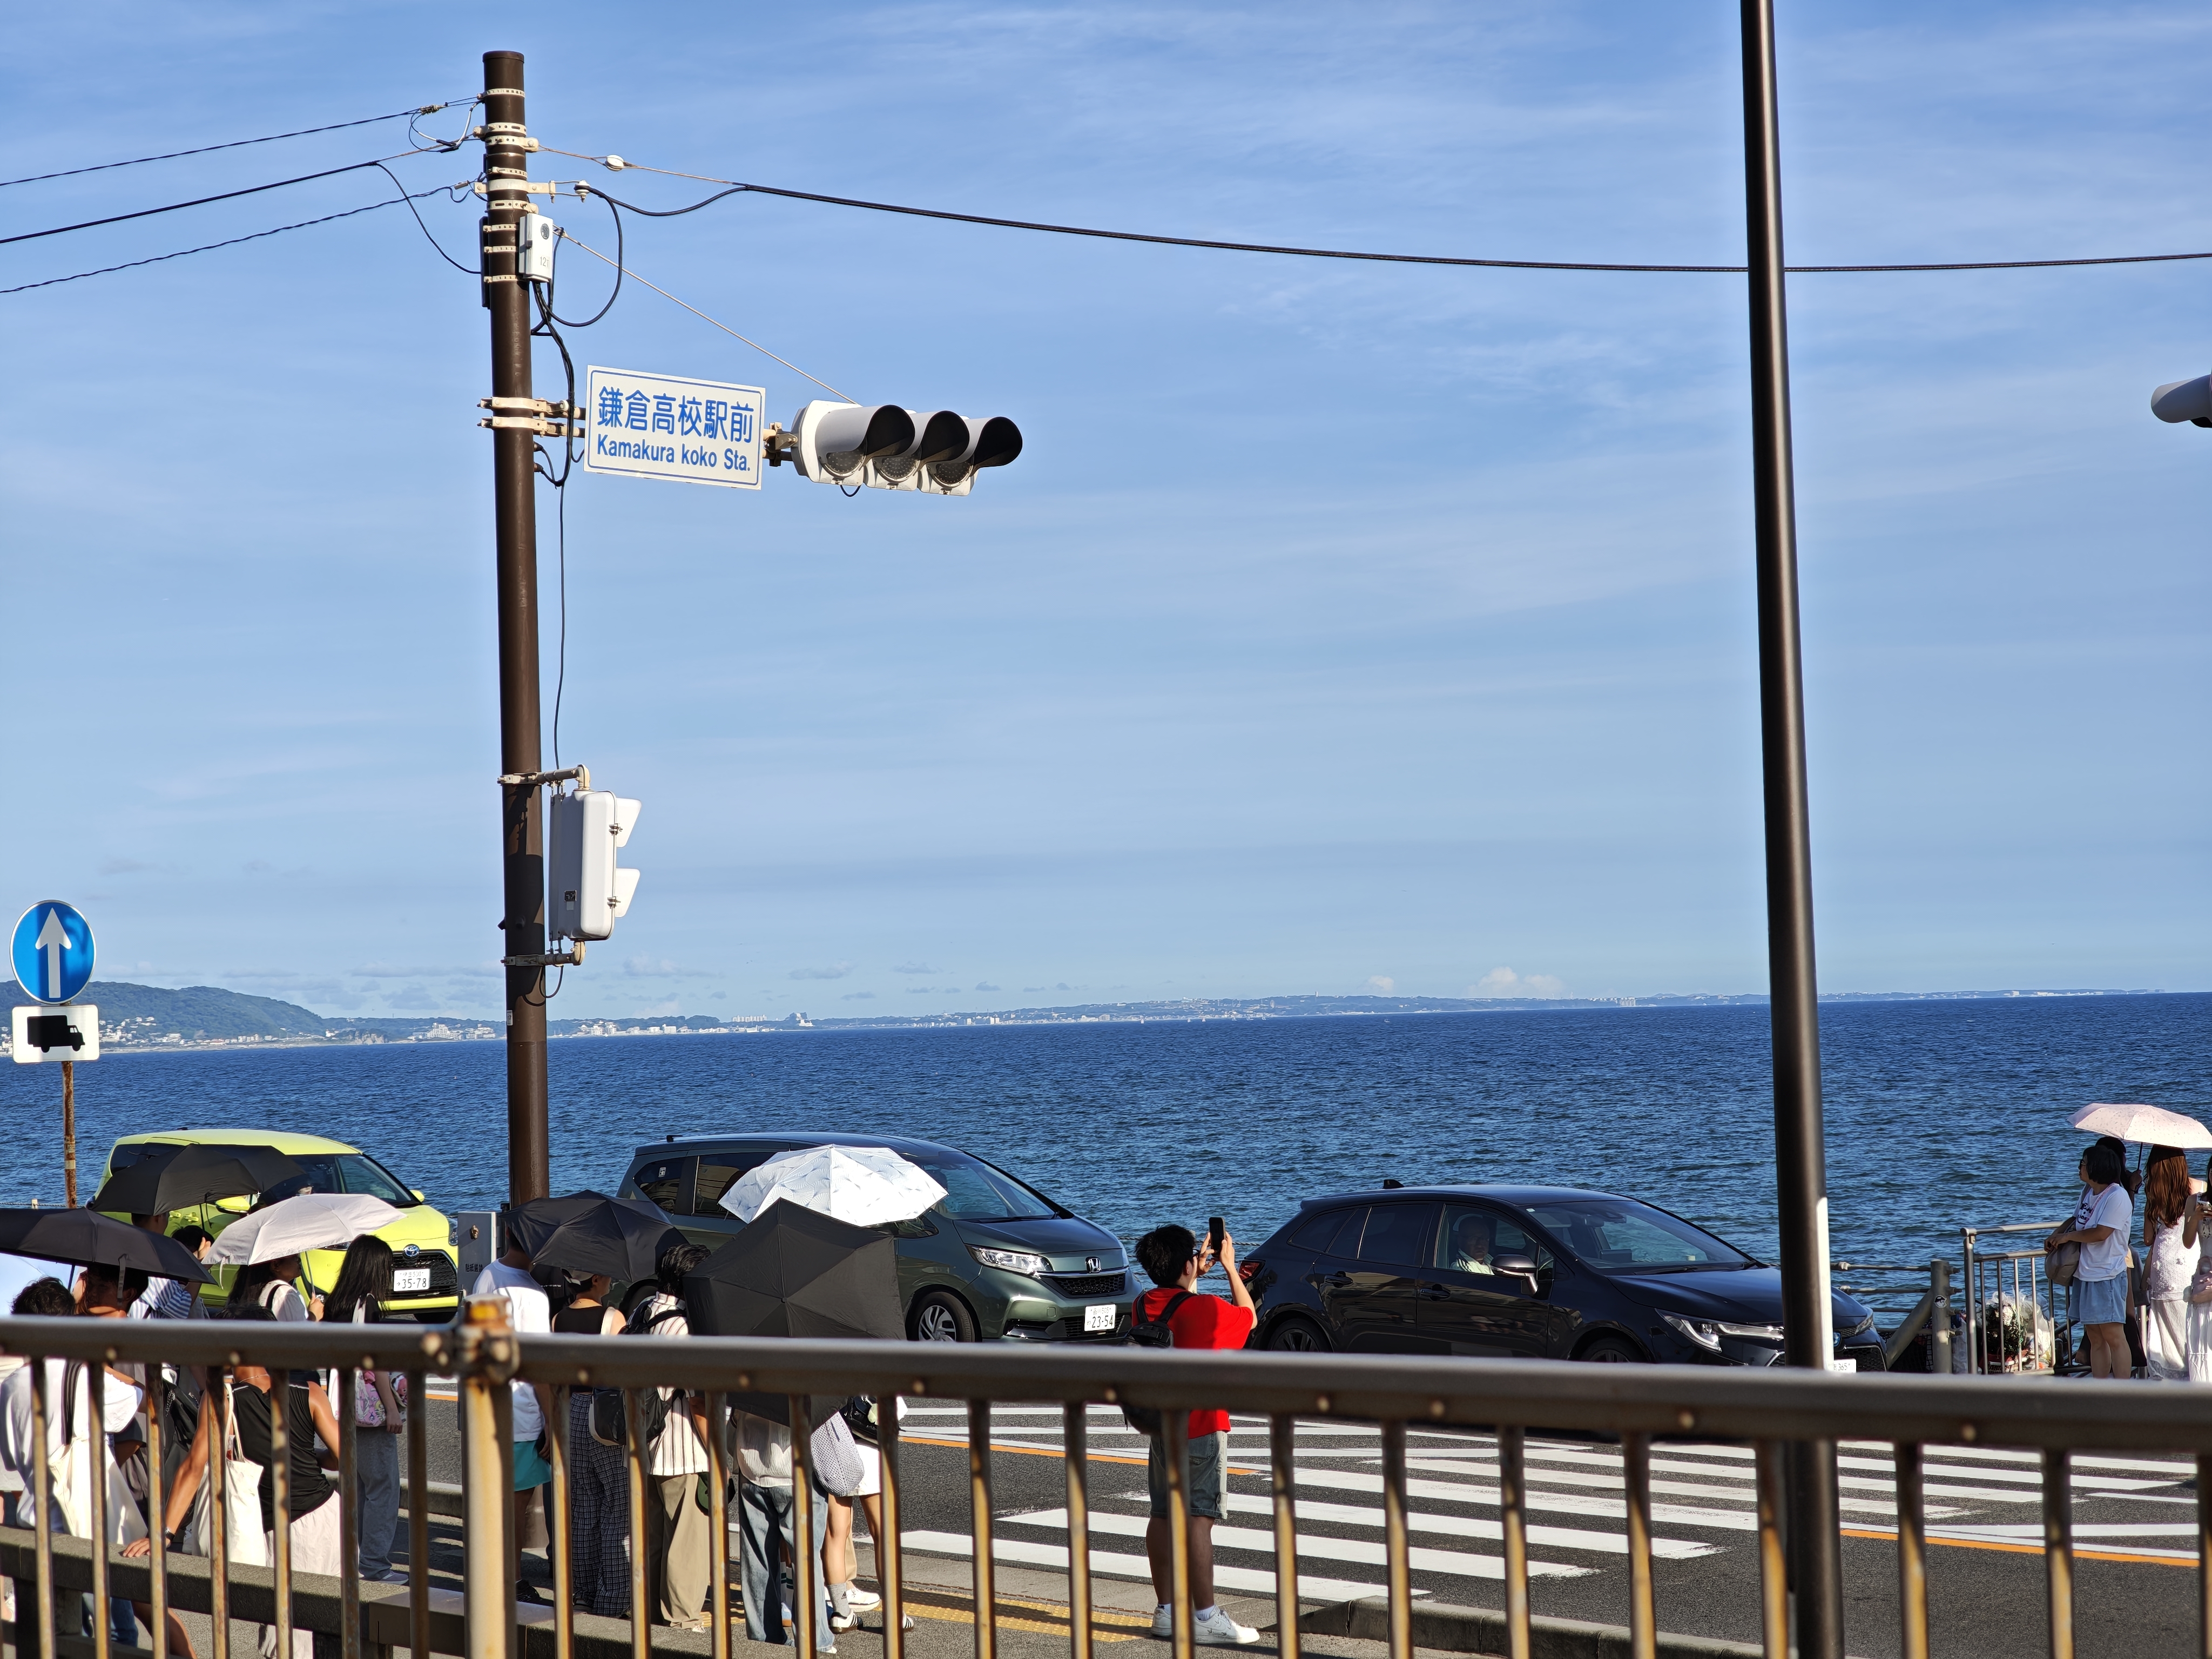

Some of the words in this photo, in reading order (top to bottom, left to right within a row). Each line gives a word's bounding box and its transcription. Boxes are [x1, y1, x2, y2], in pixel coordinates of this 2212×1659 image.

[597, 386, 754, 443] 鎌倉高校駅前
[597, 434, 675, 463] Kamakura
[681, 443, 717, 468] koko
[724, 448, 751, 471] Sta.
[402, 1278, 427, 1289] 35-78
[1092, 1314, 1113, 1328] 23-54
